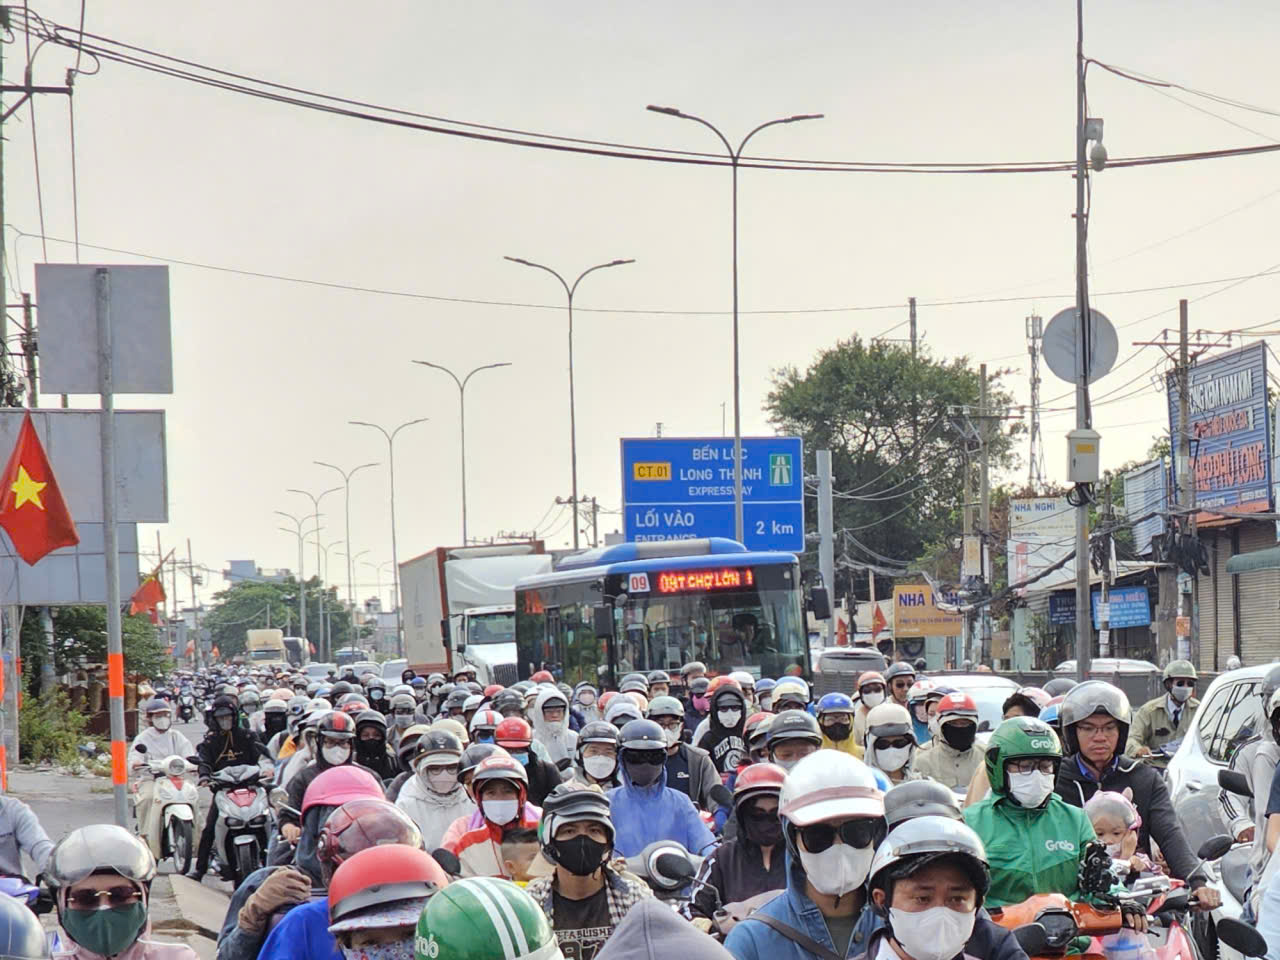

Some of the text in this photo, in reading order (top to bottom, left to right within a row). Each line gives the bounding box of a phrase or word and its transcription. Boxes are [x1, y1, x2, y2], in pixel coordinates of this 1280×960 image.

[692, 445, 719, 460] BẾN
[1235, 441, 1265, 484] LONG
[638, 466, 668, 478] CT.01
[680, 468, 713, 481] LONG
[635, 509, 695, 527] LỐI VÀO
[756, 520, 794, 535] 2 km
[631, 576, 648, 591] 09
[1031, 739, 1055, 750] Grab
[1045, 839, 1075, 852] Grab
